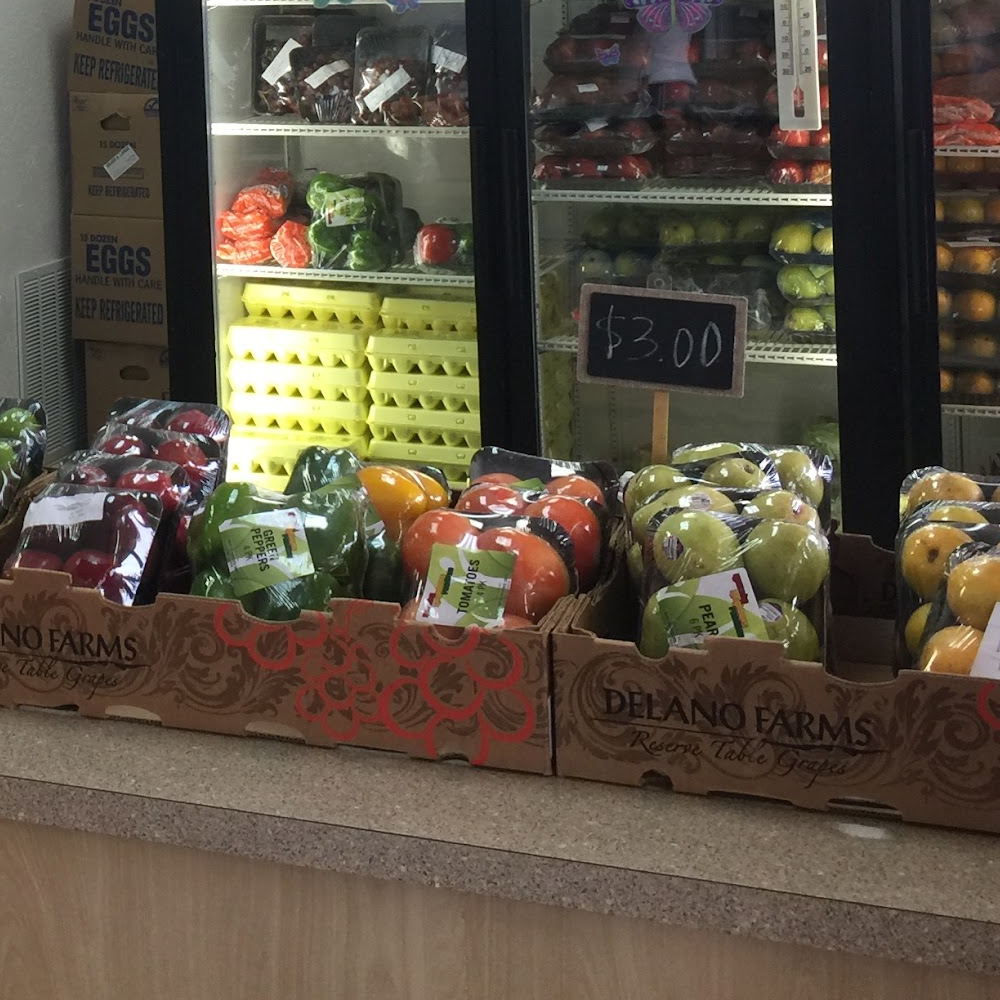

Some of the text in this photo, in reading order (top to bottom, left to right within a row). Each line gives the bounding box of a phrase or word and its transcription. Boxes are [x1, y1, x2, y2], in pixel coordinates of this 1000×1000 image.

[88, 2, 155, 43] EGGS
[76, 32, 158, 56] HANDLE WITH CAR
[74, 53, 159, 91] KEEP REFRIGERATE
[90, 234, 118, 244] DOZEN
[86, 243, 151, 277] EGGS
[75, 274, 162, 290] HANDLE WITH CARE
[75, 297, 163, 325] KEEP REFRIGERATED
[596, 304, 722, 368] $3.00
[250, 528, 270, 572] PEPPERS
[457, 559, 480, 614] TOMATOES
[49, 628, 138, 661] FARMS
[16, 658, 60, 680] Table
[66, 666, 119, 700] Grapes
[603, 687, 873, 747] DELANO FARMS
[630, 730, 847, 790] Reserve Table Grapes
